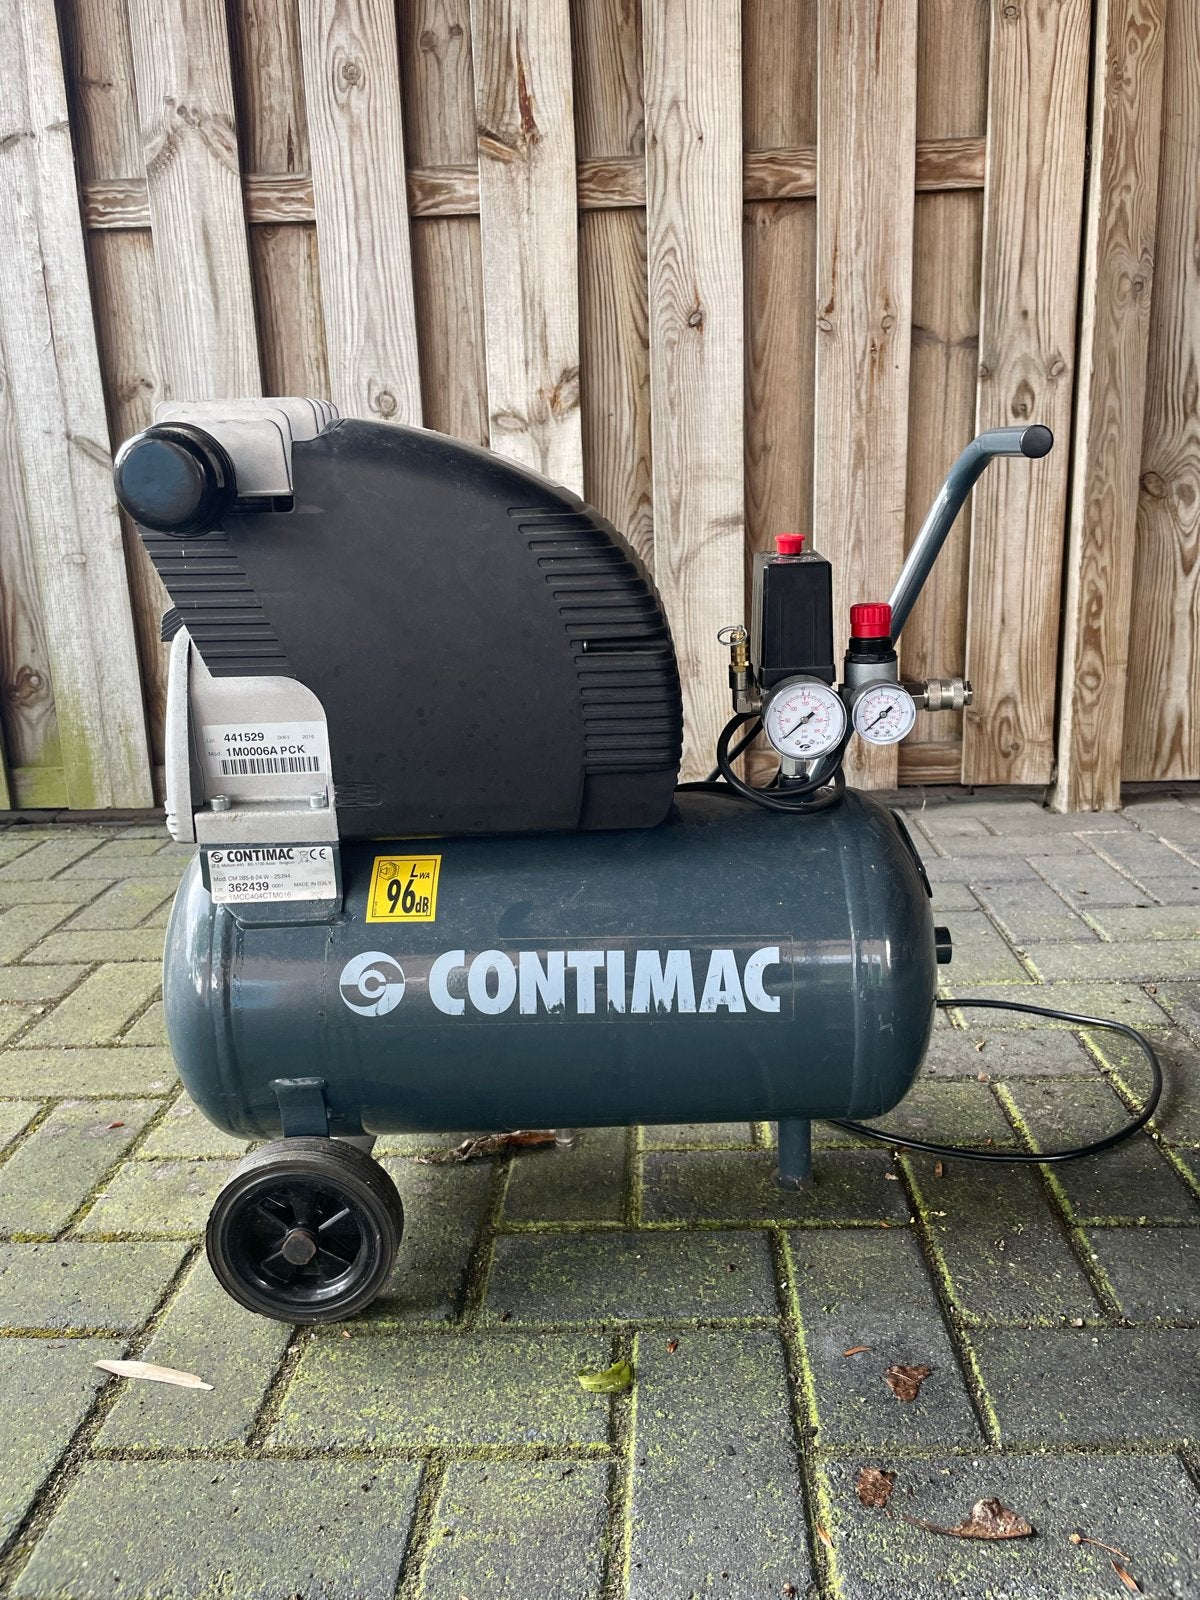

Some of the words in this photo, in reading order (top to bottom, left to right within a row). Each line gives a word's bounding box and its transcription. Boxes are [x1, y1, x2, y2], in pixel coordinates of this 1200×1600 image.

[223, 732, 265, 742] 441529
[225, 746, 278, 757] 1M0006A
[280, 745, 306, 755] PCK
[226, 848, 295, 862] CONTIMAC
[228, 881, 270, 893] 362439
[428, 946, 781, 1015] CONTIMAC
